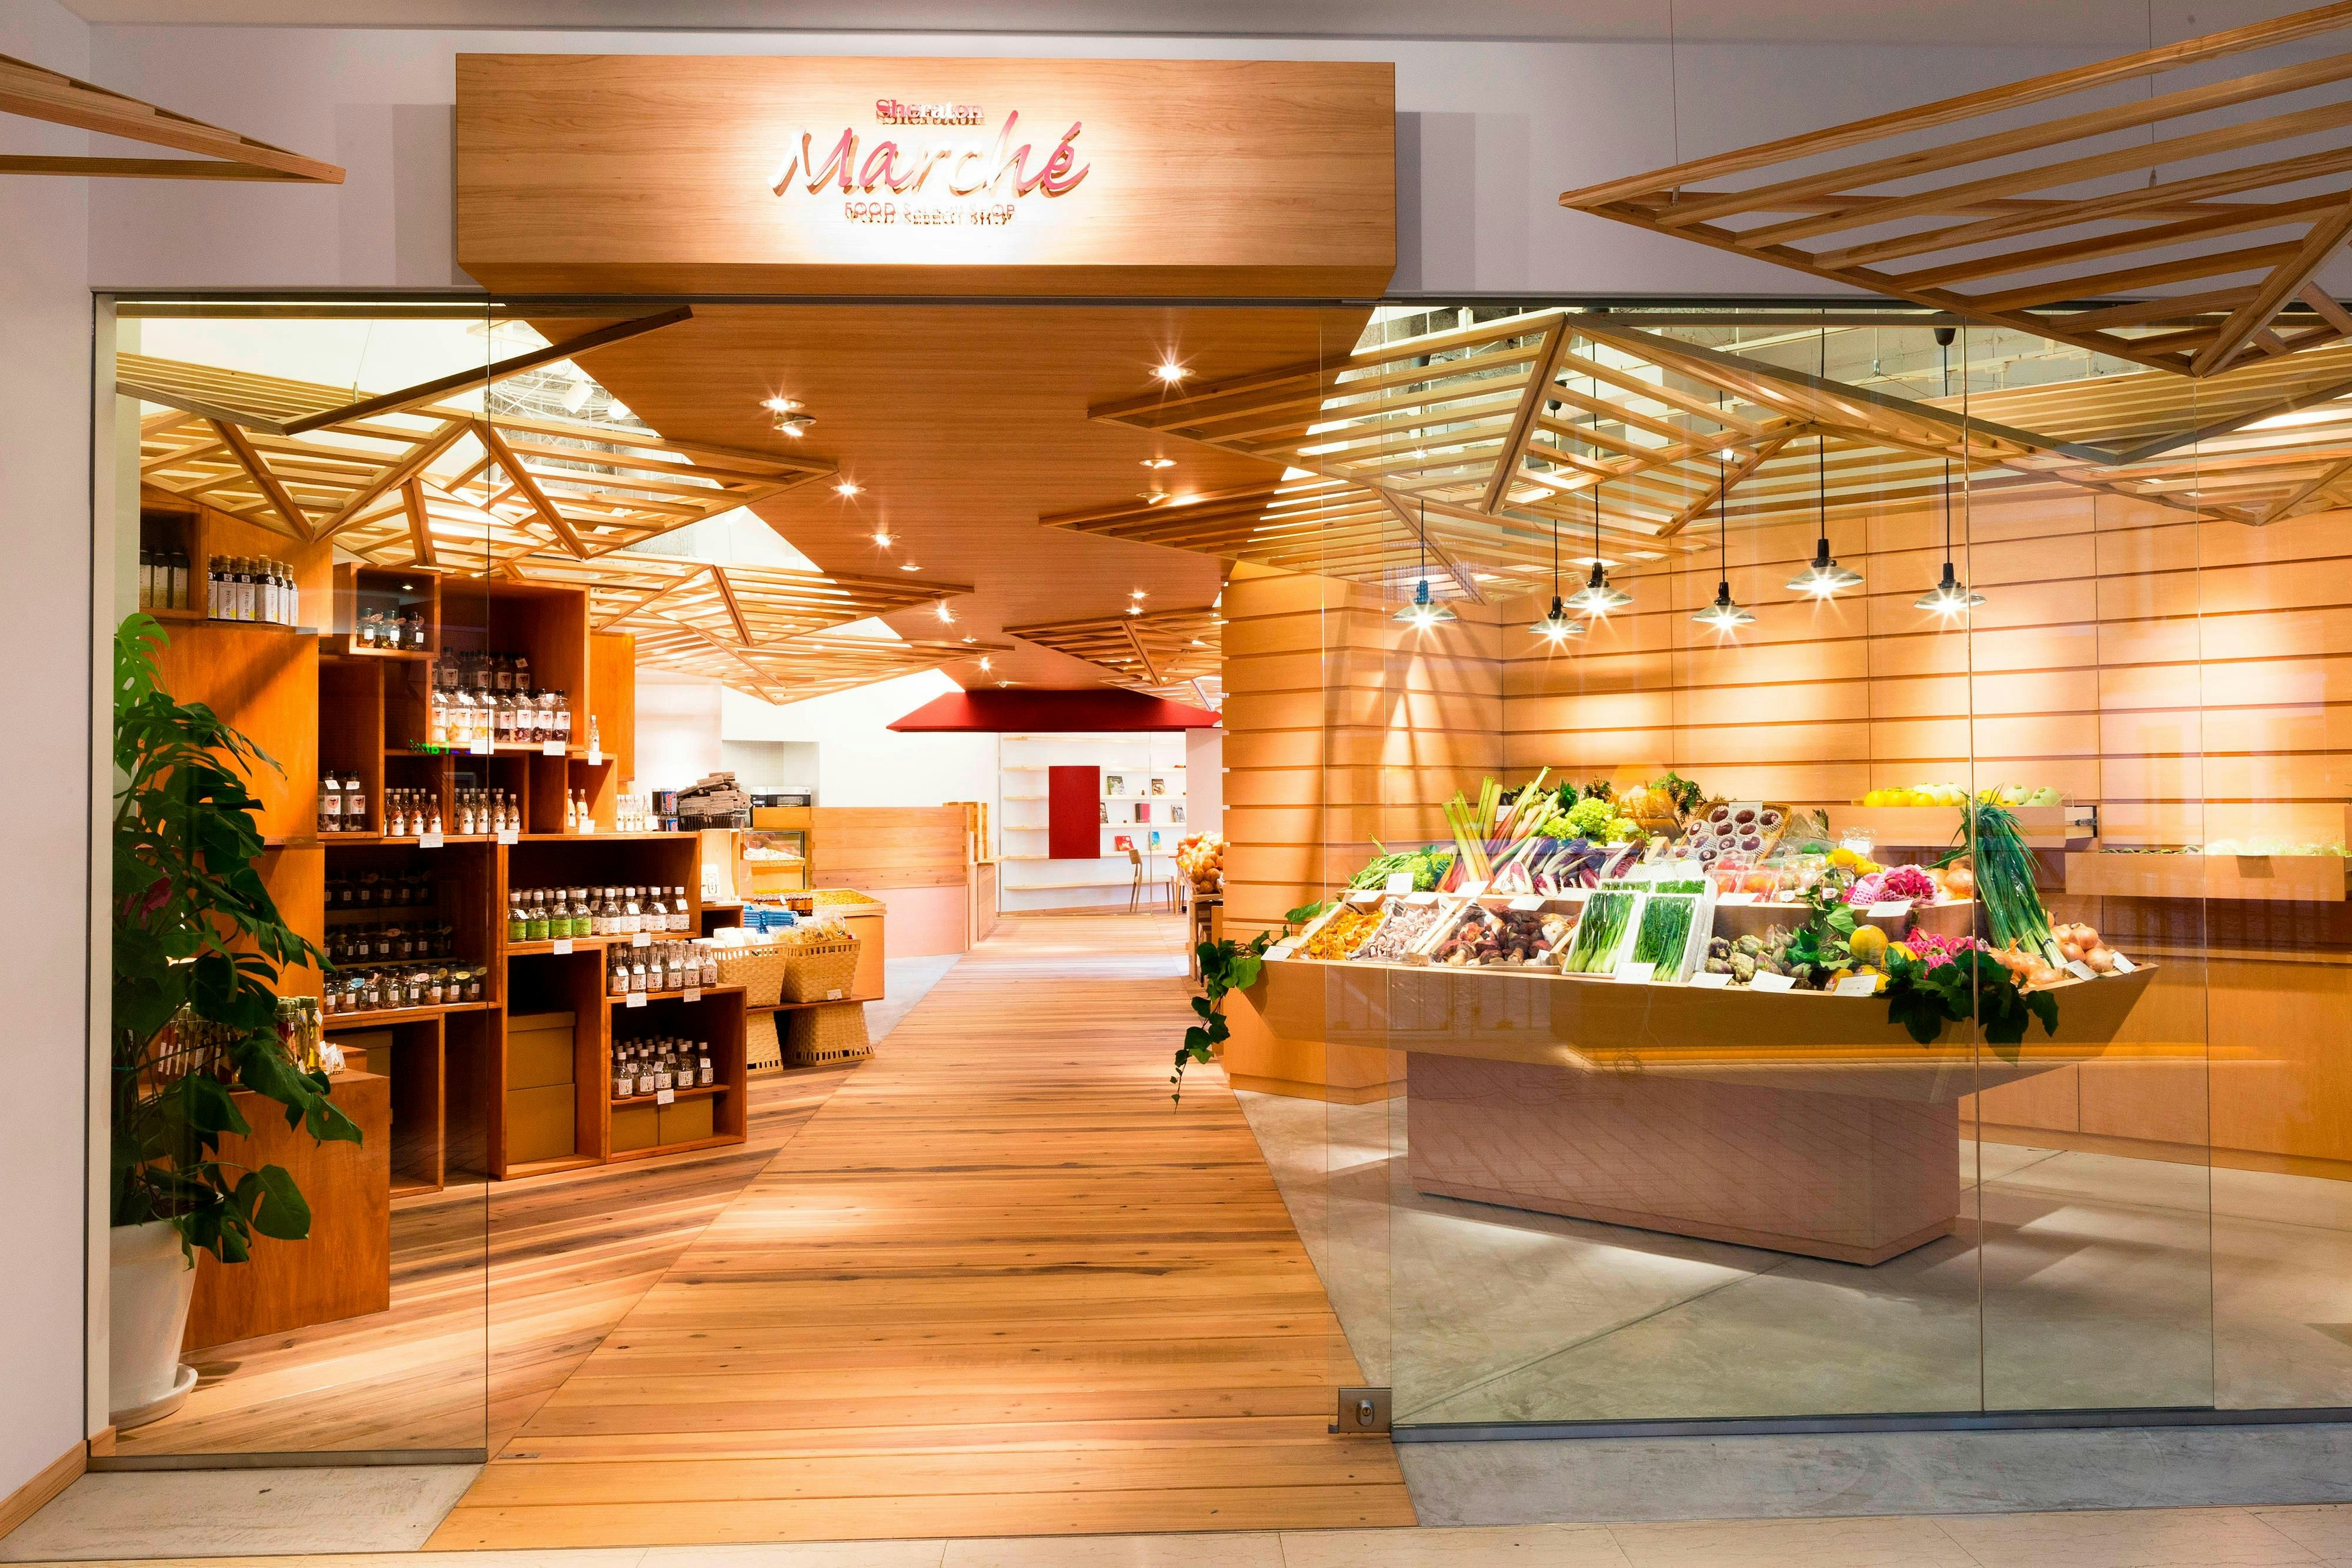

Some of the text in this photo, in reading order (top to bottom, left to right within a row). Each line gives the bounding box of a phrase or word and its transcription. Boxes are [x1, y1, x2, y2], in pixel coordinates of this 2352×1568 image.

[876, 99, 984, 120] Sheraton
[767, 110, 1091, 195] Marché
[845, 202, 896, 219] FOOD
[970, 203, 1015, 220] SHOP
